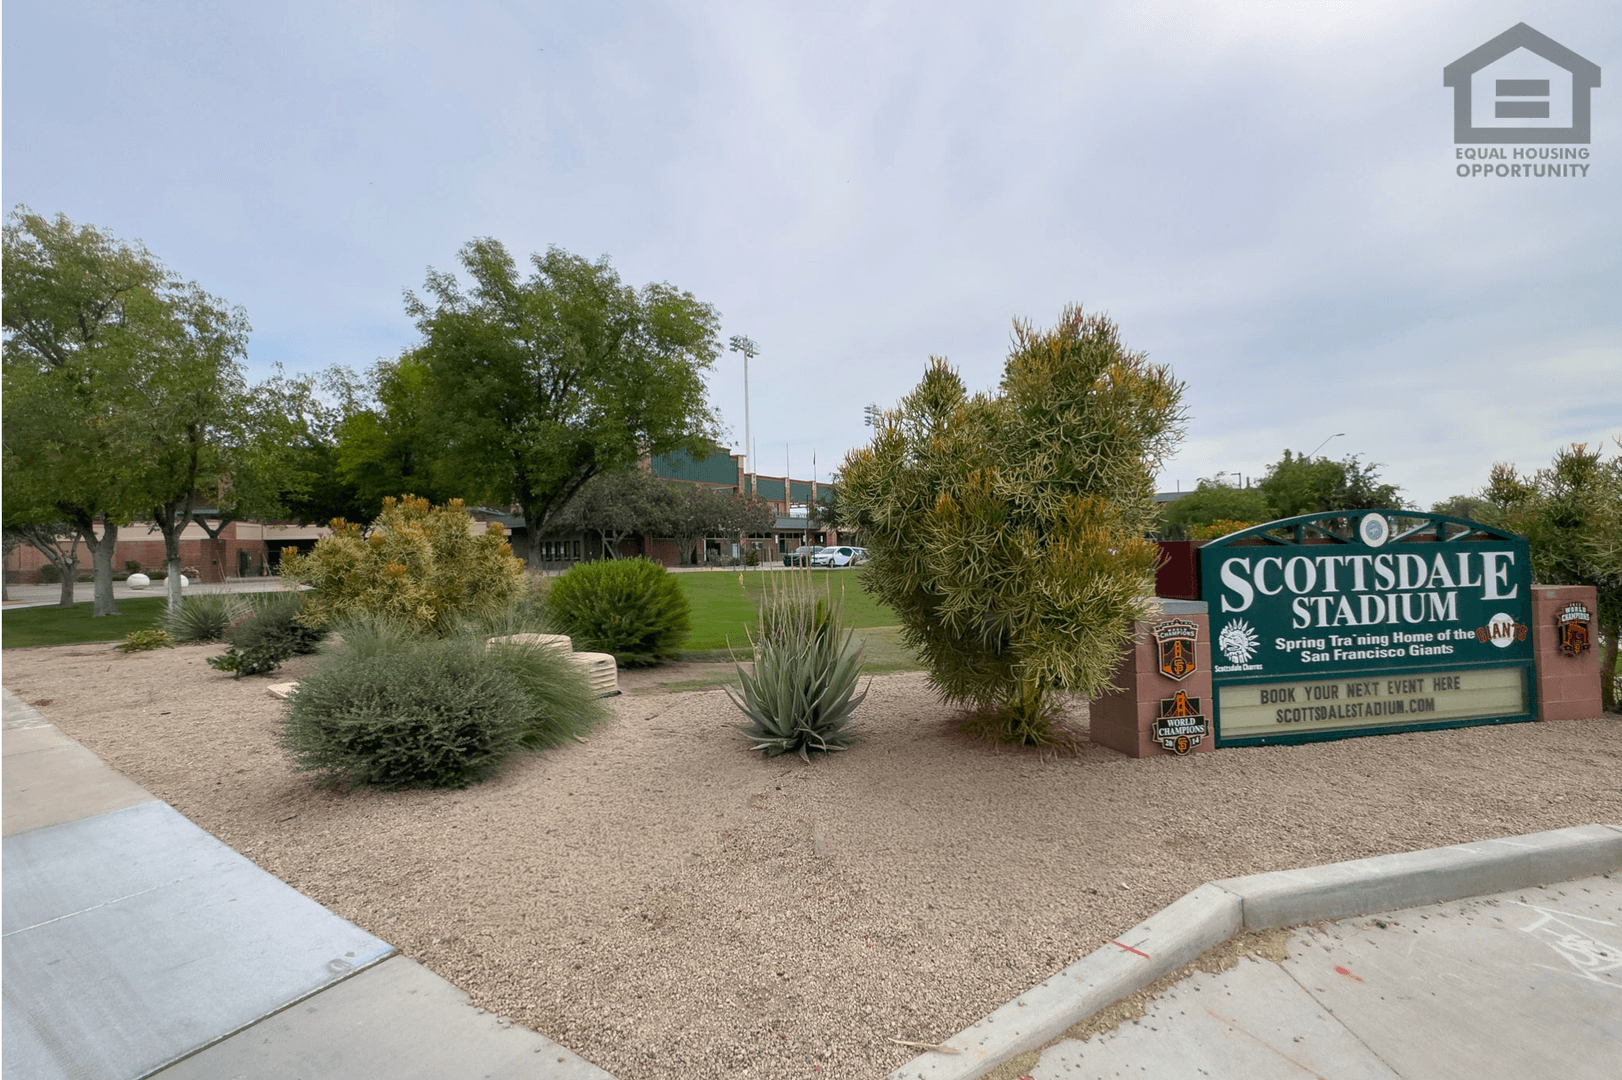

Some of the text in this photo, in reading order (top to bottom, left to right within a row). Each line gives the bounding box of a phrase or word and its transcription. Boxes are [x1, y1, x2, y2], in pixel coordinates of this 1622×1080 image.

[1220, 551, 1518, 613] SCOTTSDALE
[1292, 591, 1459, 630] STADIUM
[1160, 629, 1195, 639] CHAMPIONS
[1275, 628, 1476, 652] Spring Traning Home of the
[1476, 621, 1528, 643] GIANTS
[1300, 644, 1454, 662] San Francisco Giants
[1214, 663, 1242, 673] Scottsdale
[1260, 676, 1461, 704] BOOK YOUR NEXT EVENT HERE
[1276, 697, 1436, 724] SCOTTSDALESTADIUM.COM
[1158, 724, 1205, 736] CHAMPIONS
[1167, 717, 1196, 727] WORLD
[1165, 736, 1200, 747] 20 14
